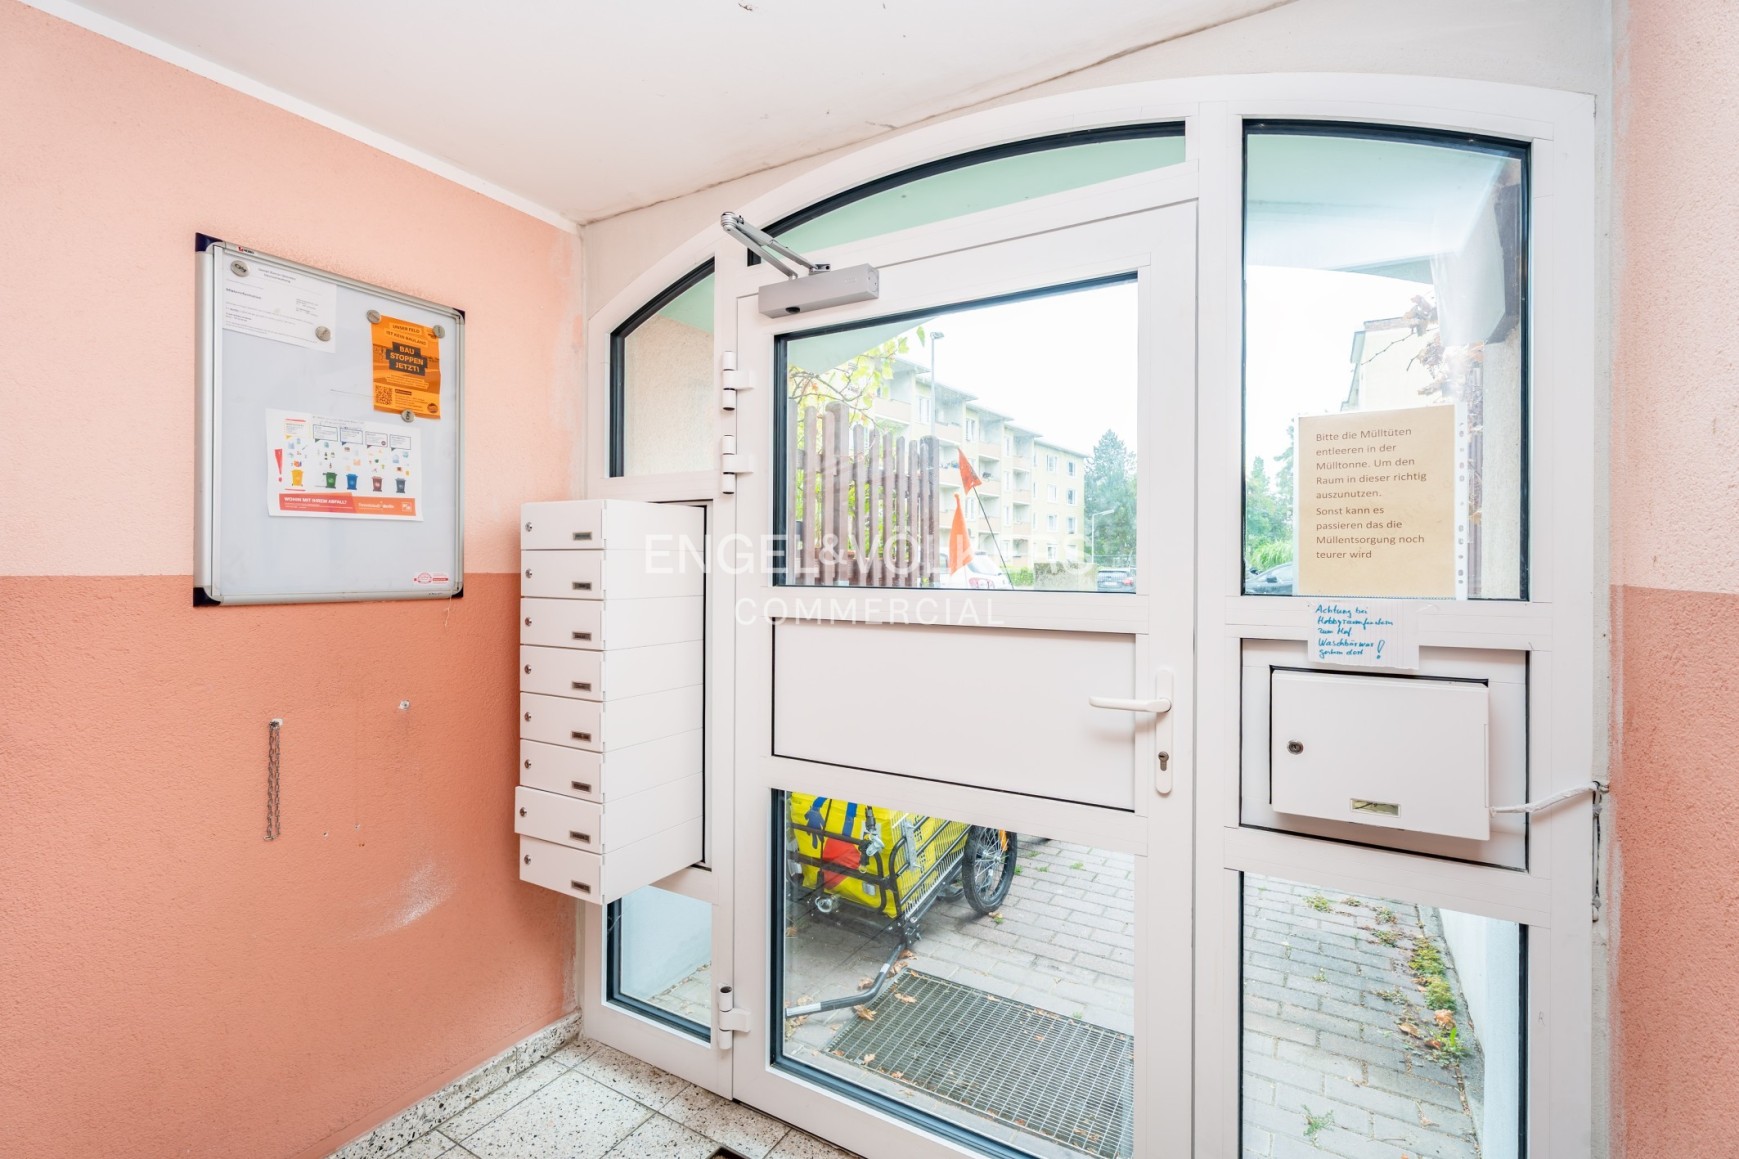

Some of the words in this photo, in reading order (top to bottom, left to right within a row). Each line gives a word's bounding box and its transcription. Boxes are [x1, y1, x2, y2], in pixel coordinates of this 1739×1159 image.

[399, 345, 415, 354] BAU
[390, 352, 424, 366] STOPPEN
[395, 362, 420, 373] JETZT!
[1316, 433, 1339, 441] Bitte
[1341, 431, 1357, 440] die
[1360, 428, 1412, 439] Mülltüten
[1316, 446, 1364, 456] entleeren
[1366, 445, 1376, 453] in
[1379, 444, 1397, 452] der
[1316, 461, 1371, 471] Mülltonne.
[1373, 459, 1392, 468] Um
[1394, 458, 1415, 466] den
[1316, 476, 1344, 485] Raum
[1347, 475, 1356, 483] in
[1359, 474, 1391, 483] dieser
[1393, 472, 1427, 482] richtig
[1316, 490, 1382, 499] auszunutzen.
[1316, 507, 1343, 515] Sonst
[1345, 506, 1370, 514] kann
[1316, 521, 1363, 531] passieren
[1365, 520, 1384, 529] das
[1386, 520, 1403, 529] die
[1316, 535, 1396, 545] Müllentsorgung
[1398, 534, 1425, 543] noch
[1316, 551, 1347, 559] teurer
[1349, 550, 1372, 559] wird
[1315, 604, 1352, 618] Achtung
[1355, 606, 1369, 615] bei
[1337, 626, 1352, 637] Hof
[1345, 648, 1364, 656] dort
